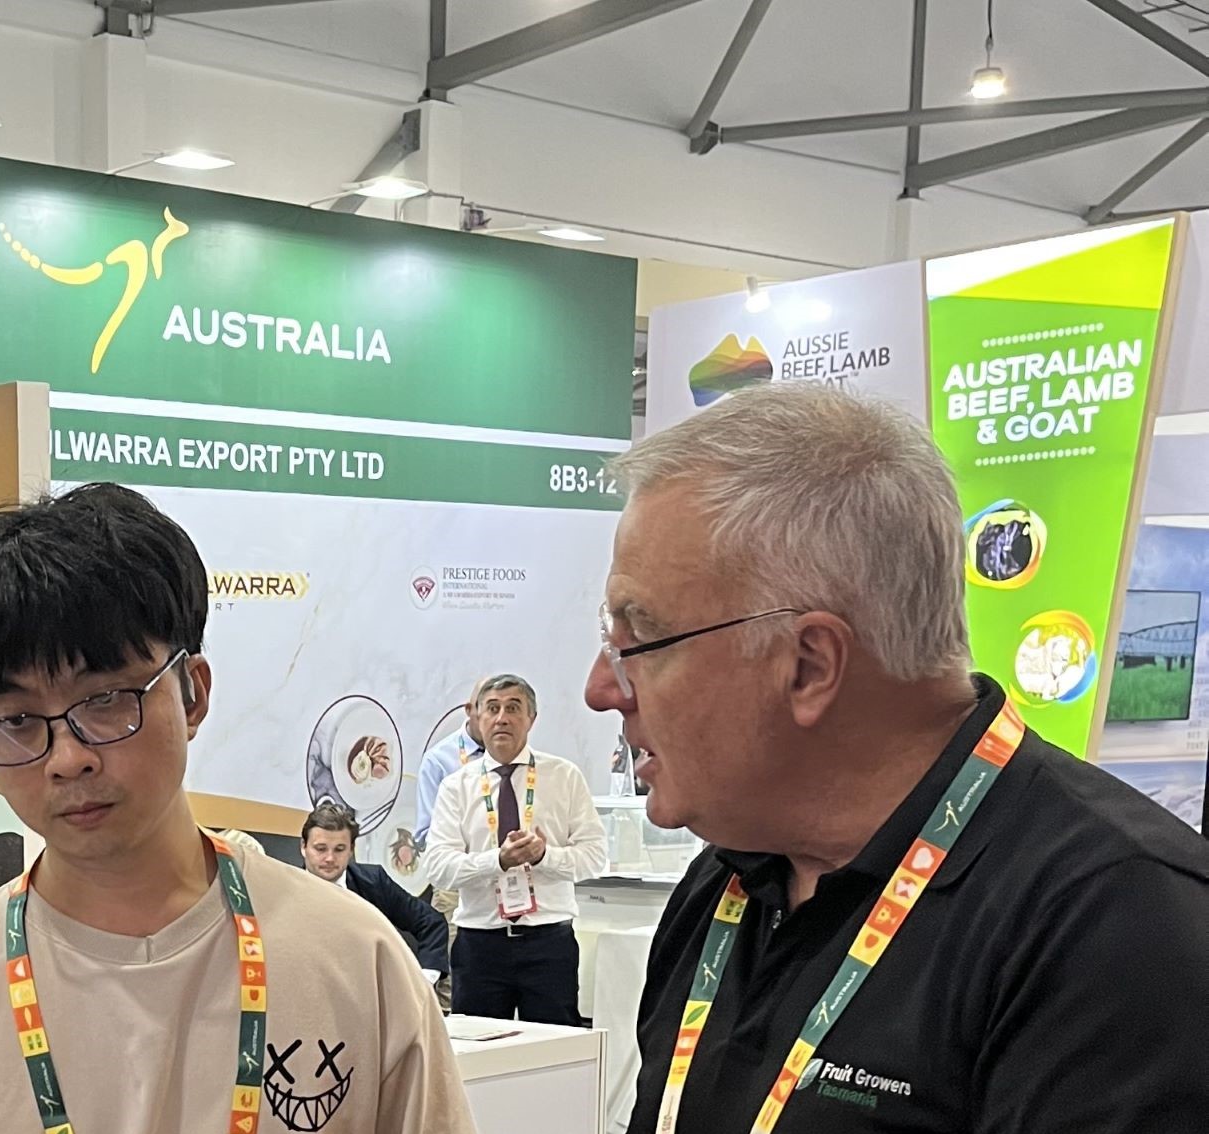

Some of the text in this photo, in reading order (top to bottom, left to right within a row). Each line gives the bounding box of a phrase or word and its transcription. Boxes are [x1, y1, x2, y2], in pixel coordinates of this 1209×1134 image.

[162, 304, 392, 364] AUSTRALIA
[782, 331, 850, 359] AUSSIE
[942, 338, 1143, 393] AUSTRALIAN
[947, 371, 1135, 420] BEEF, LAMB
[976, 405, 1100, 445] & GOAT
[49, 429, 385, 480] LWARRA EXPORT PTY LTD
[208, 576, 296, 596] WARRA
[442, 567, 527, 581] PRESTIGE FOODS
[957, 771, 987, 813] AUSTRALIA
[829, 970, 858, 1012] AUSTRALIA
[816, 1079, 878, 1108] Tasmania
[819, 1062, 912, 1096] Fruit Growers
